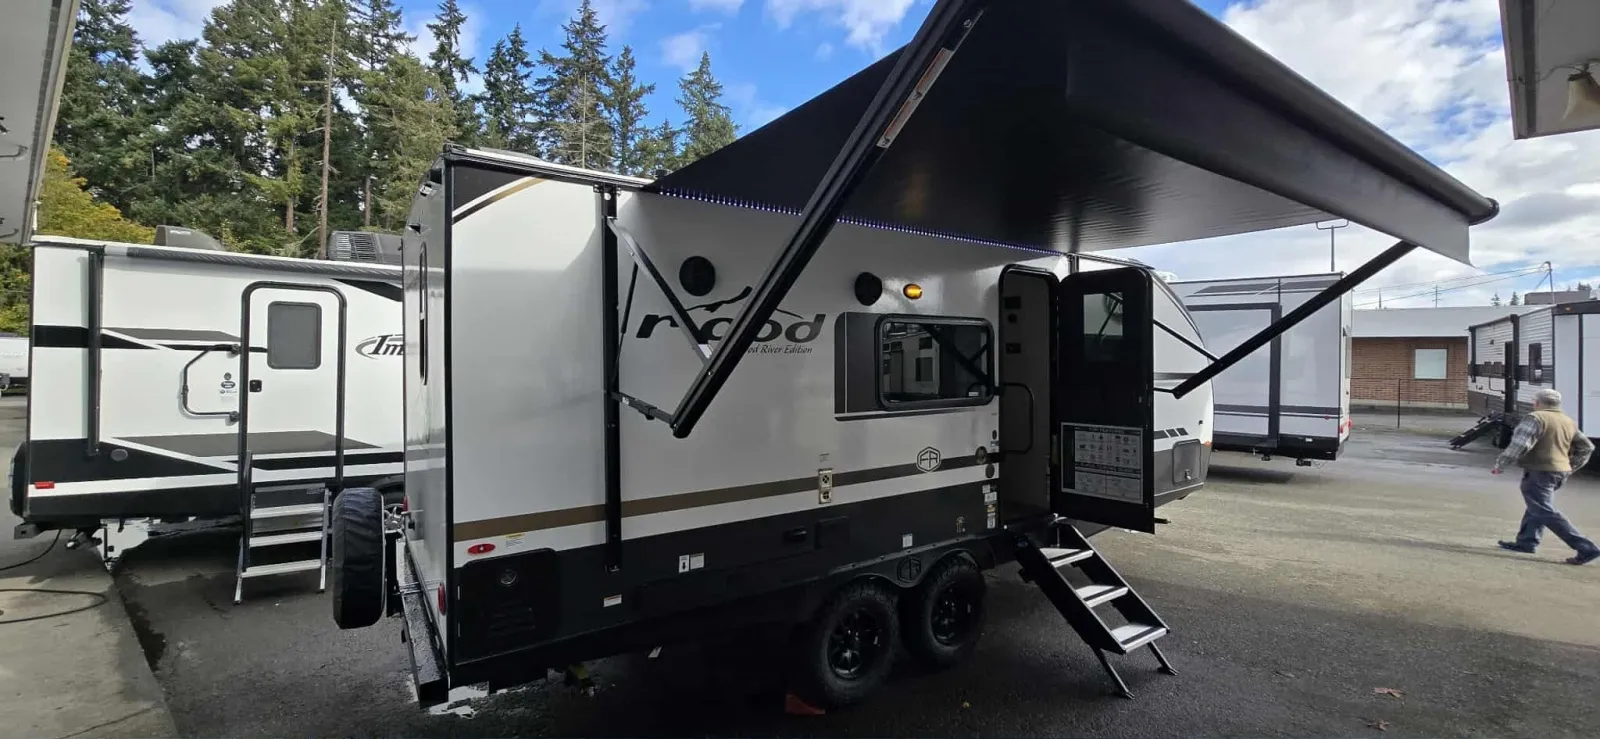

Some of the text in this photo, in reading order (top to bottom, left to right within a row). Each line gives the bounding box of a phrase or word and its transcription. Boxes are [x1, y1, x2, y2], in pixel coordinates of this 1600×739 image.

[367, 334, 403, 356] Im
[761, 344, 781, 354] River
[783, 343, 813, 354] Edition
